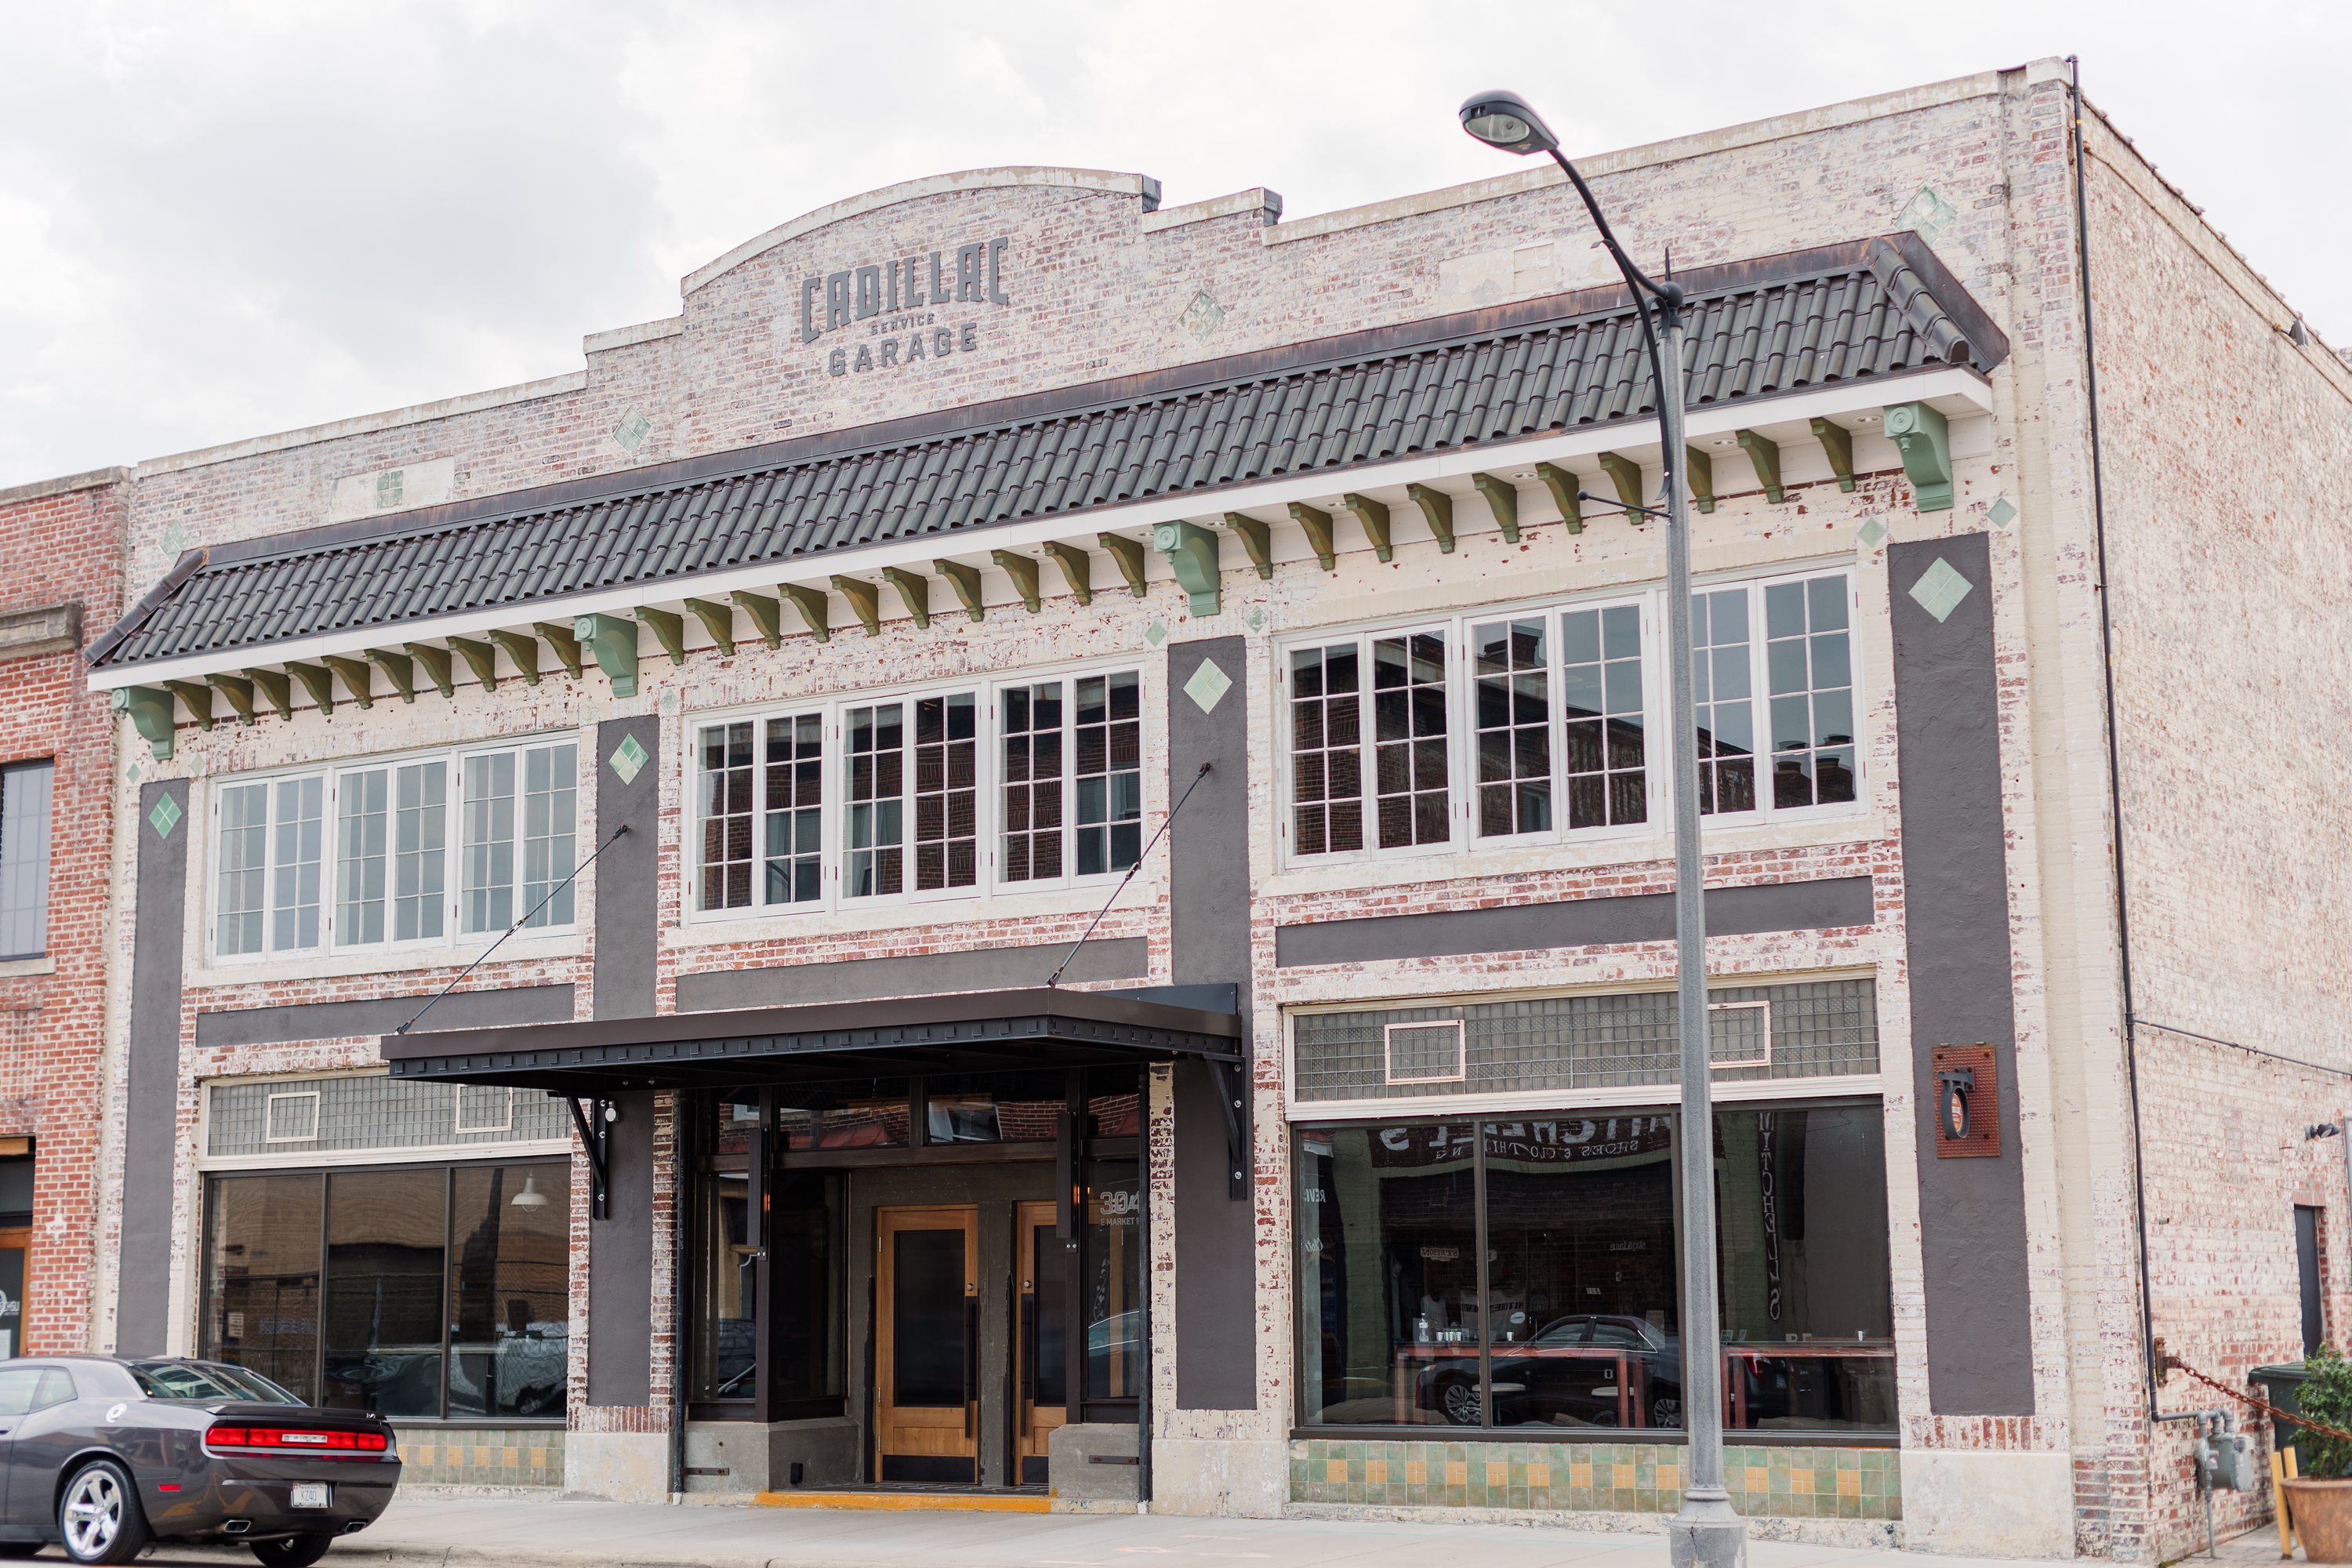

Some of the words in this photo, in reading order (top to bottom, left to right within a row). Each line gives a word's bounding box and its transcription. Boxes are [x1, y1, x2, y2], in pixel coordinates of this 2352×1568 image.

[801, 236, 1009, 344] CADILLAC
[870, 313, 935, 335] SERVICE
[828, 321, 978, 377] GARAGE
[1100, 1191, 1140, 1214] 304
[1106, 1217, 1135, 1225] MARKET
